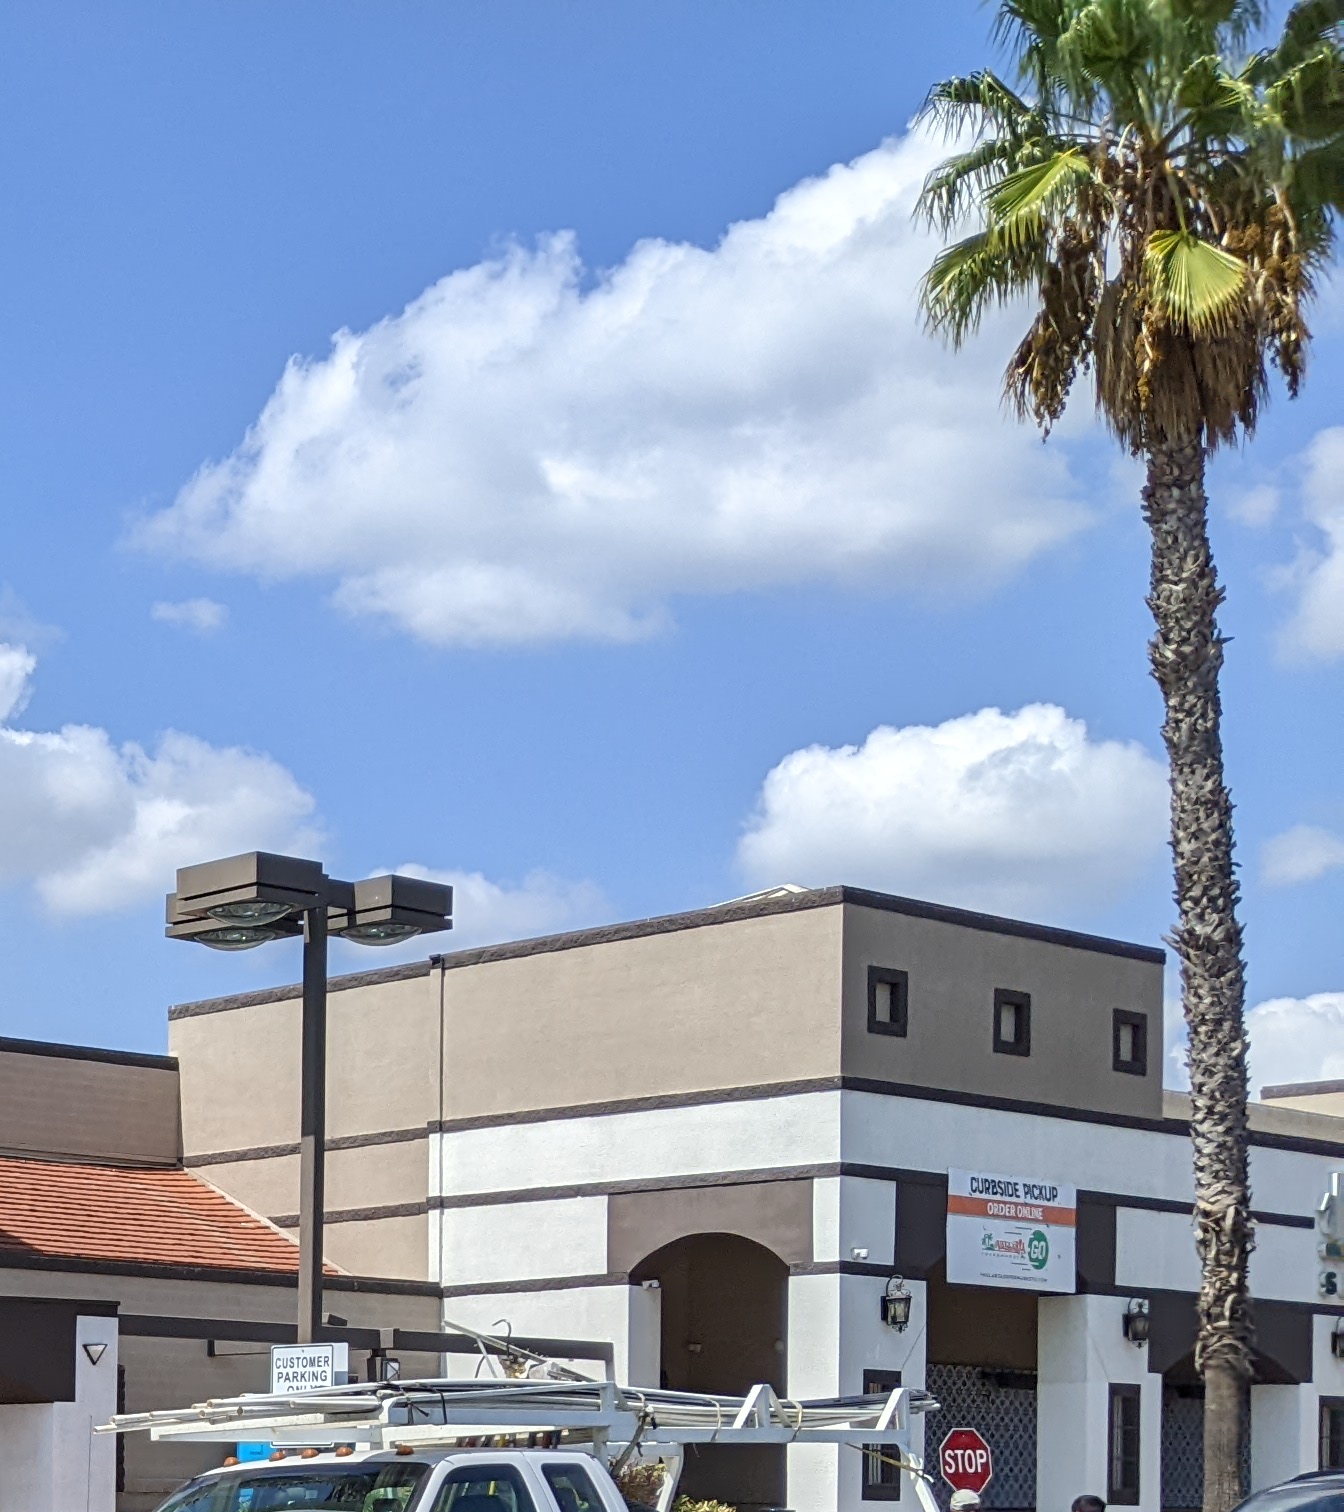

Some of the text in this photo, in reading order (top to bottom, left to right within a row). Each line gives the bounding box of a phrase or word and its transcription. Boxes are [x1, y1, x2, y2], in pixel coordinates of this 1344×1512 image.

[970, 1176, 1058, 1202] CURBSIDE PICKUP
[987, 1202, 1044, 1220] ORDER ONLINE
[1031, 1240, 1047, 1260] GO
[275, 1355, 330, 1369] CUSTOMER
[277, 1369, 328, 1384] PARKING
[944, 1449, 987, 1474] STOP
